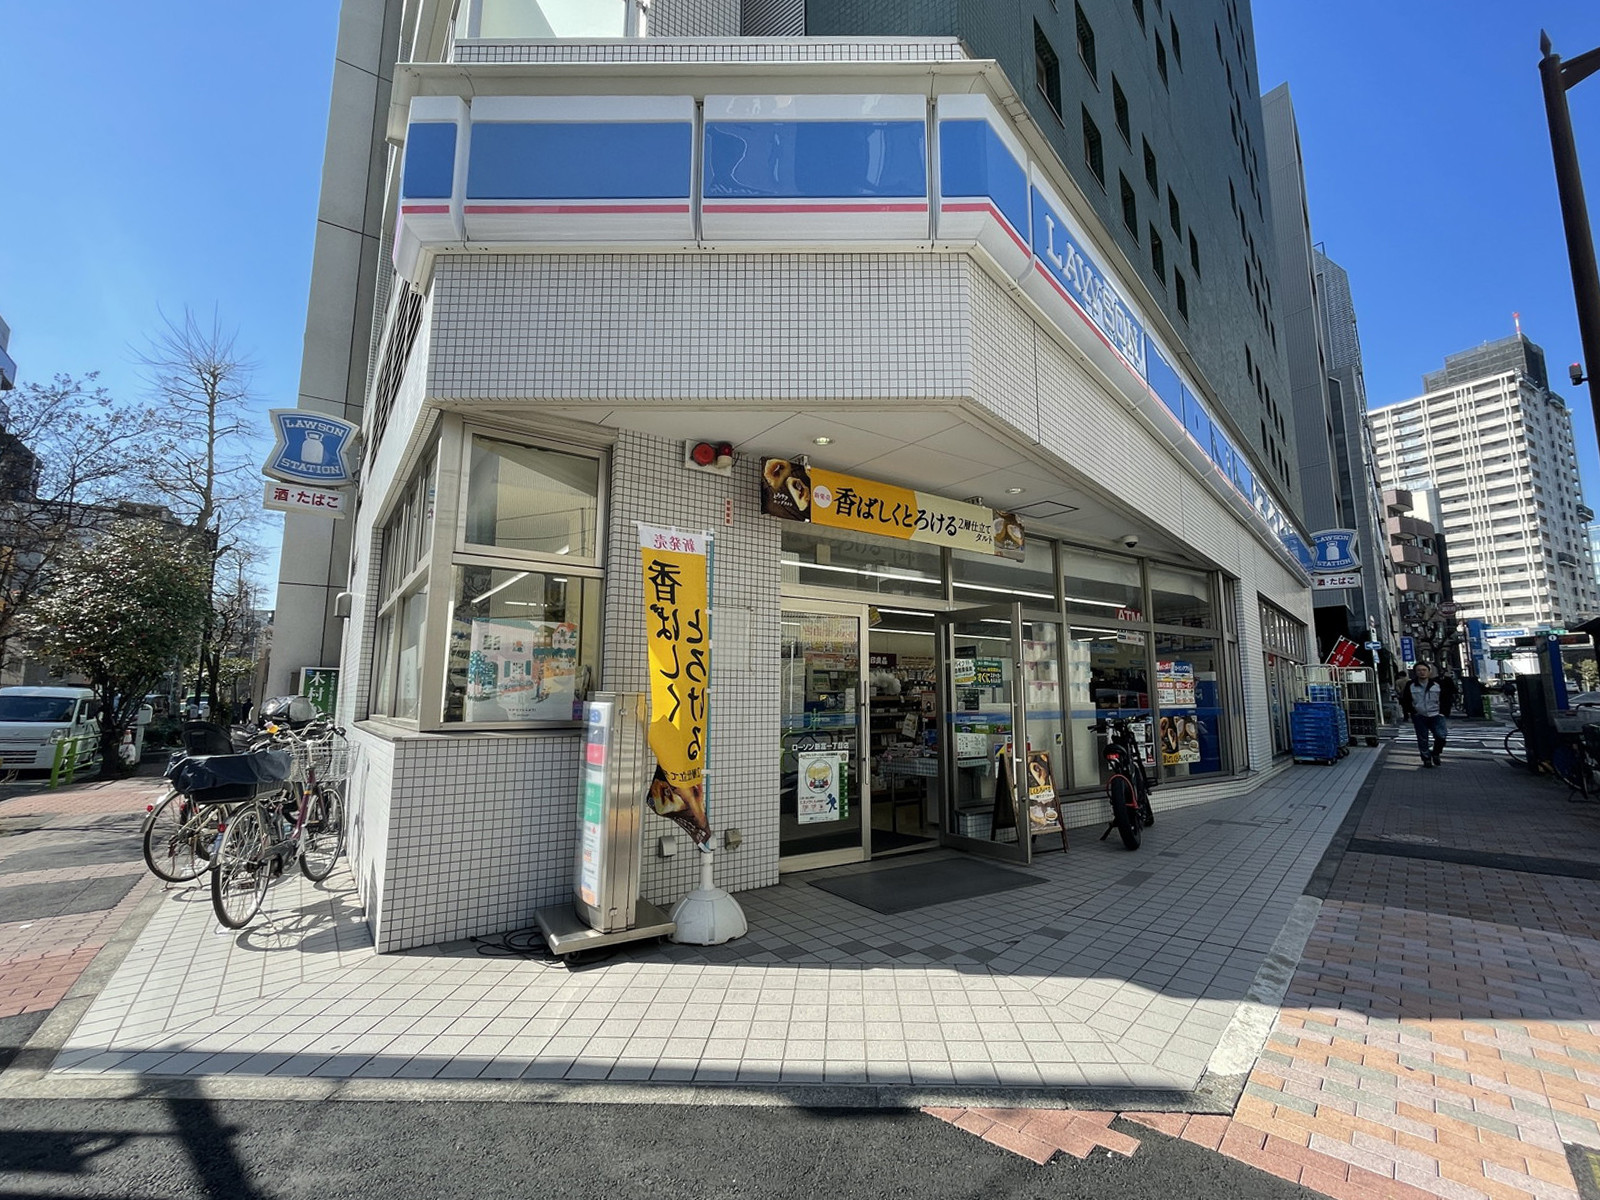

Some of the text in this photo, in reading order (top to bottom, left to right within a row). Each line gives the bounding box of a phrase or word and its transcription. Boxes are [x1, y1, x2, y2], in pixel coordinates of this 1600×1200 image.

[1045, 213, 1140, 364] LAWSON
[285, 419, 345, 438] LAWSON
[280, 457, 341, 475] STATION
[273, 487, 339, 509] 酒・たばこ
[834, 487, 957, 537] 香ばしくとろける
[1315, 533, 1350, 543] LAWSON
[1316, 558, 1352, 568] STATION
